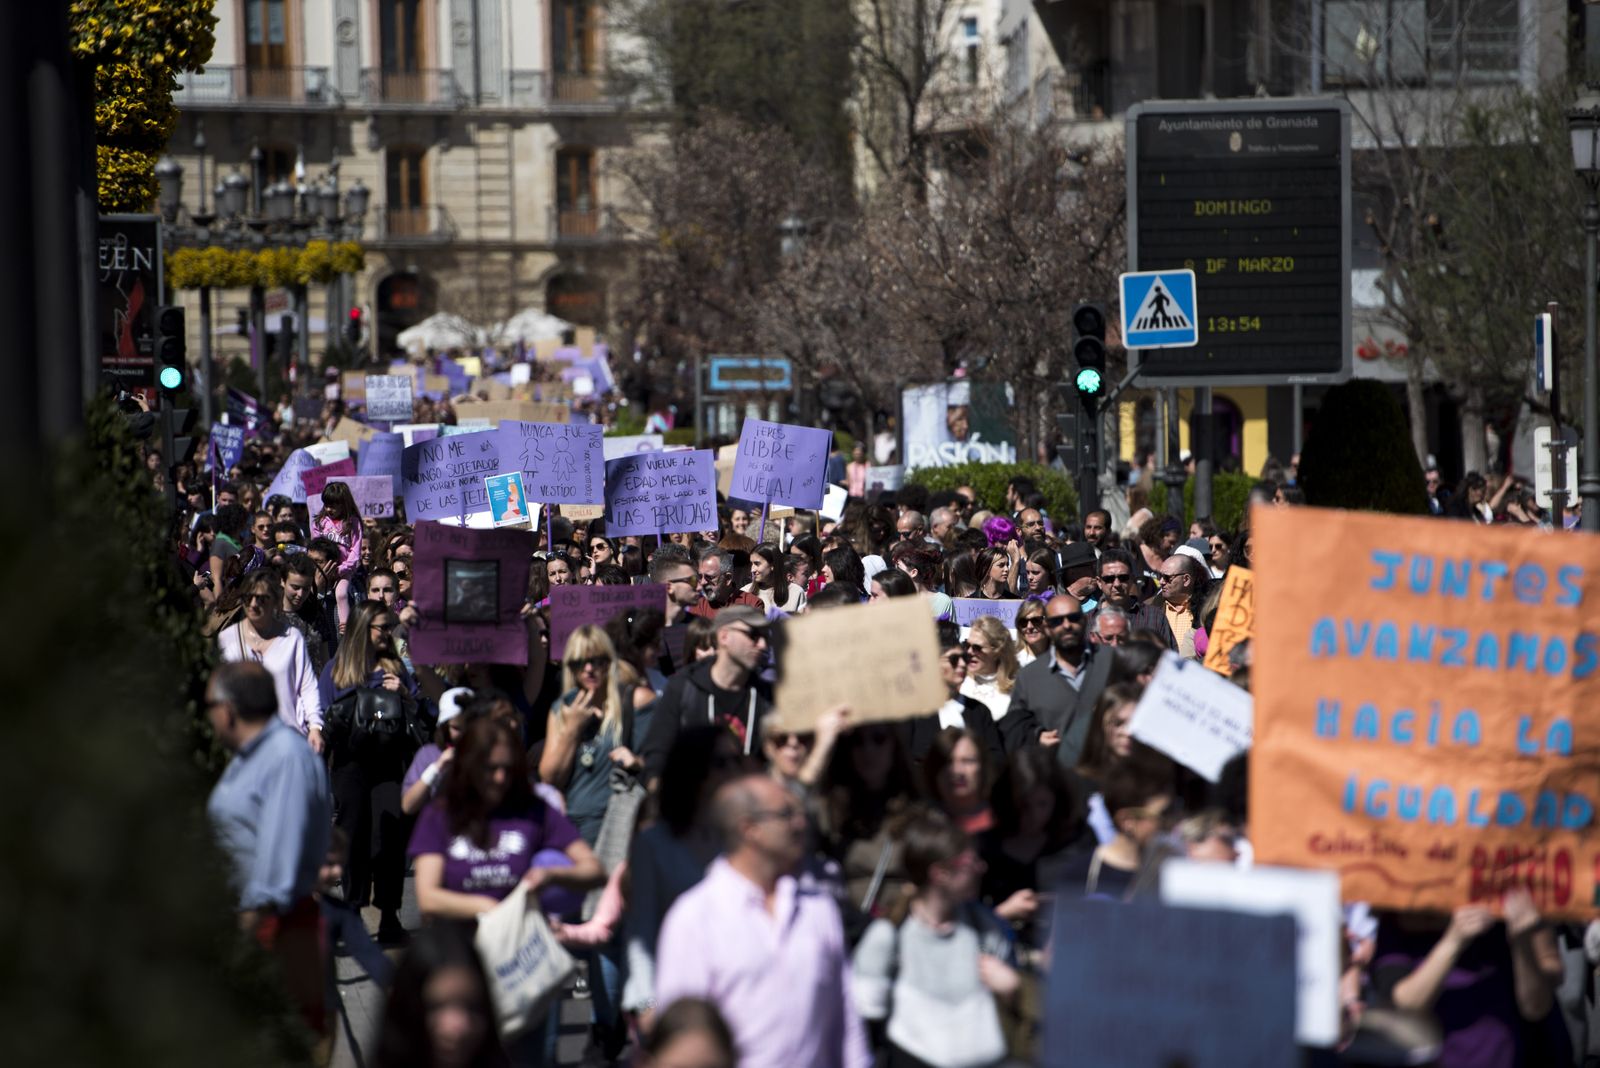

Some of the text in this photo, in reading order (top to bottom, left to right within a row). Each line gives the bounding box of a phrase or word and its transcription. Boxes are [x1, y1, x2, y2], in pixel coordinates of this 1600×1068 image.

[1158, 116, 1318, 133] Ayuntamiento de Granada
[1194, 200, 1272, 215] DOMINGO
[1238, 257, 1294, 272] MARZO
[1208, 317, 1261, 332] 13:54
[424, 441, 466, 463] NO ME
[446, 459, 500, 478] SUJETADOR
[646, 459, 678, 470] VUELVE
[683, 457, 696, 466] LA
[624, 474, 698, 491] EDAD MEDIA
[698, 488, 708, 496] DE
[743, 474, 794, 500] VUELA!
[416, 499, 433, 513] DE
[440, 494, 459, 508] LAS
[617, 500, 712, 528] LAS BRUJAS
[1369, 550, 1585, 607] JUNT@S
[1310, 617, 1600, 678] AVANZAMOS
[1515, 715, 1575, 756] LA
[1342, 771, 1595, 830] IGUALDAD
